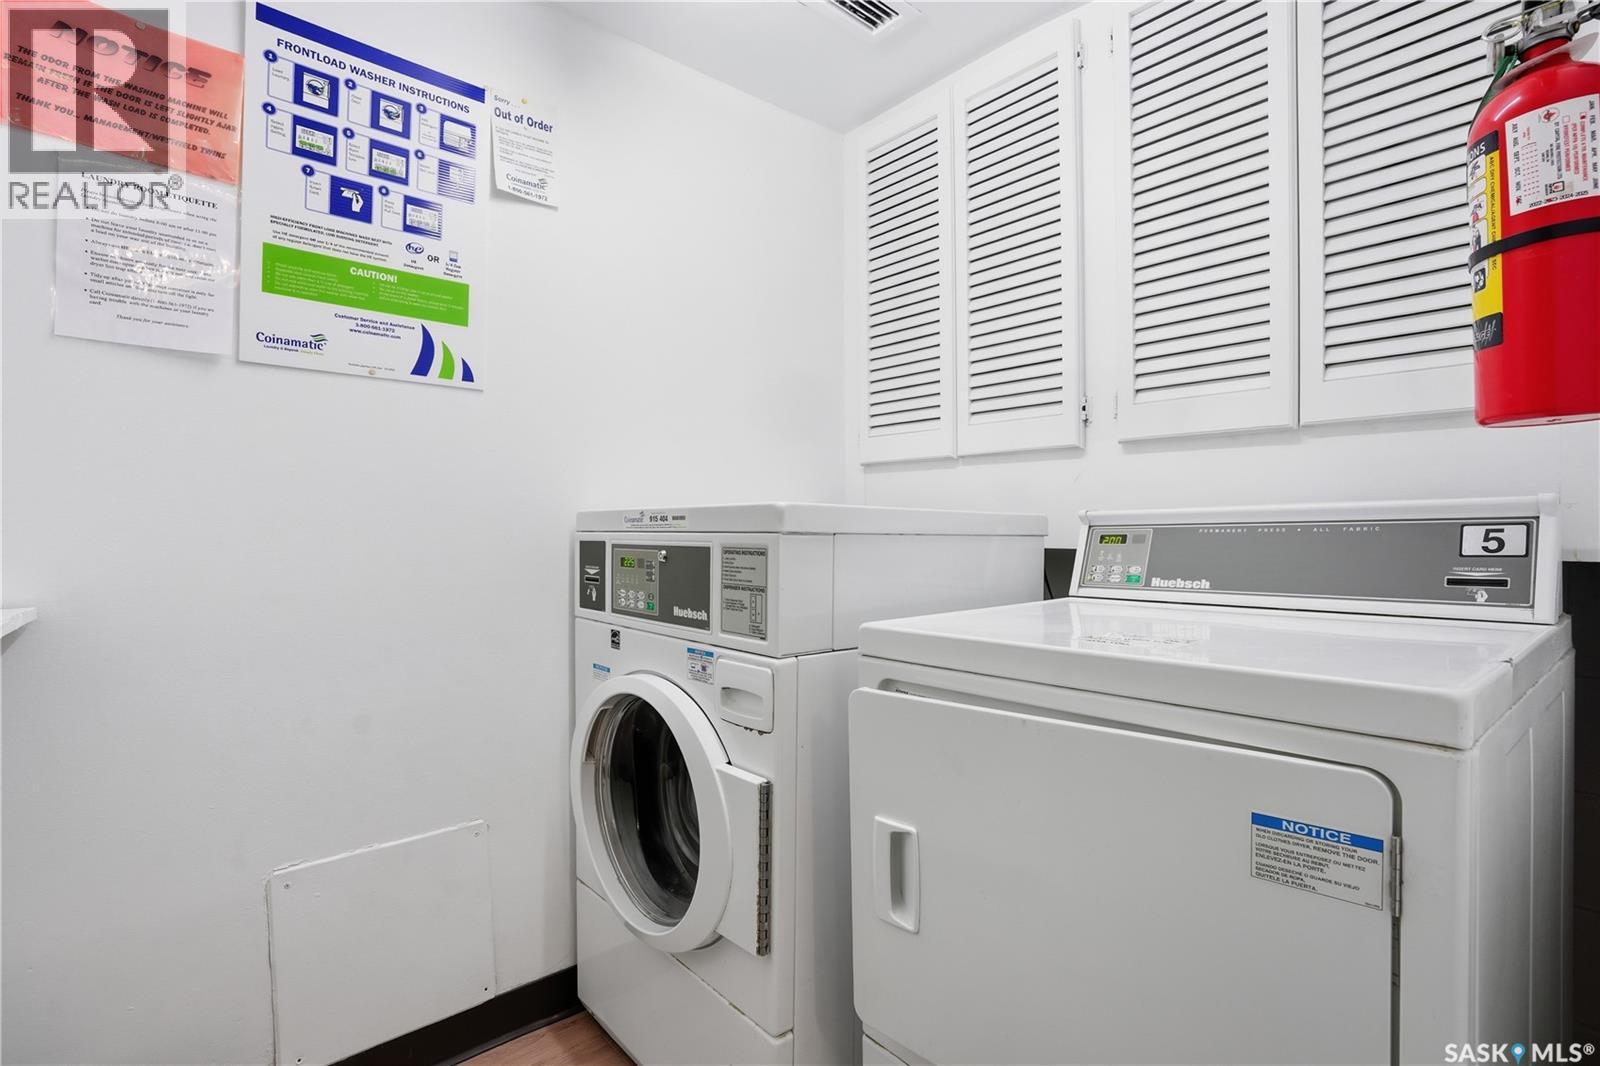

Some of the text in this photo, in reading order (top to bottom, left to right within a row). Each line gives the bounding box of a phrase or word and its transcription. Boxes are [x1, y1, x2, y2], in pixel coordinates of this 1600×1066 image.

[50, 20, 212, 88] NOTICE
[17, 46, 228, 120] THE ODOR FROM THE WASHING MACHINE WILL
[277, 39, 470, 114] FRONTLOAD WASHER INSTRUCTIONS
[16, 92, 51, 109] THANK
[37, 77, 69, 92] AFTER
[72, 88, 91, 99] THE
[94, 94, 120, 108] WASH
[123, 104, 146, 116] LOAD
[160, 115, 211, 135] COMPLETED.
[96, 84, 113, 94] THE
[115, 91, 141, 103] DOOR
[155, 102, 175, 114] LEFT
[177, 110, 215, 125] SLIGHTLY
[494, 107, 553, 133] Out of Order
[166, 191, 218, 210] ETIQUETTE
[427, 254, 440, 263] OR
[350, 267, 398, 283] CAUTION!
[256, 332, 324, 351] Coinamatic
[1481, 528, 1505, 554] 5
[1151, 577, 1210, 589] Huebsch
[673, 606, 708, 621] Huebsch
[1282, 820, 1352, 845] NOTICE
[1256, 842, 1279, 850] LORSQUE
[1296, 851, 1331, 863] ENTREPOSEZ
[1267, 836, 1290, 844] CLOTHES
[1313, 846, 1340, 856] REMOVE
[1357, 855, 1380, 865] DOOR.
[1256, 861, 1277, 869] CUANDO
